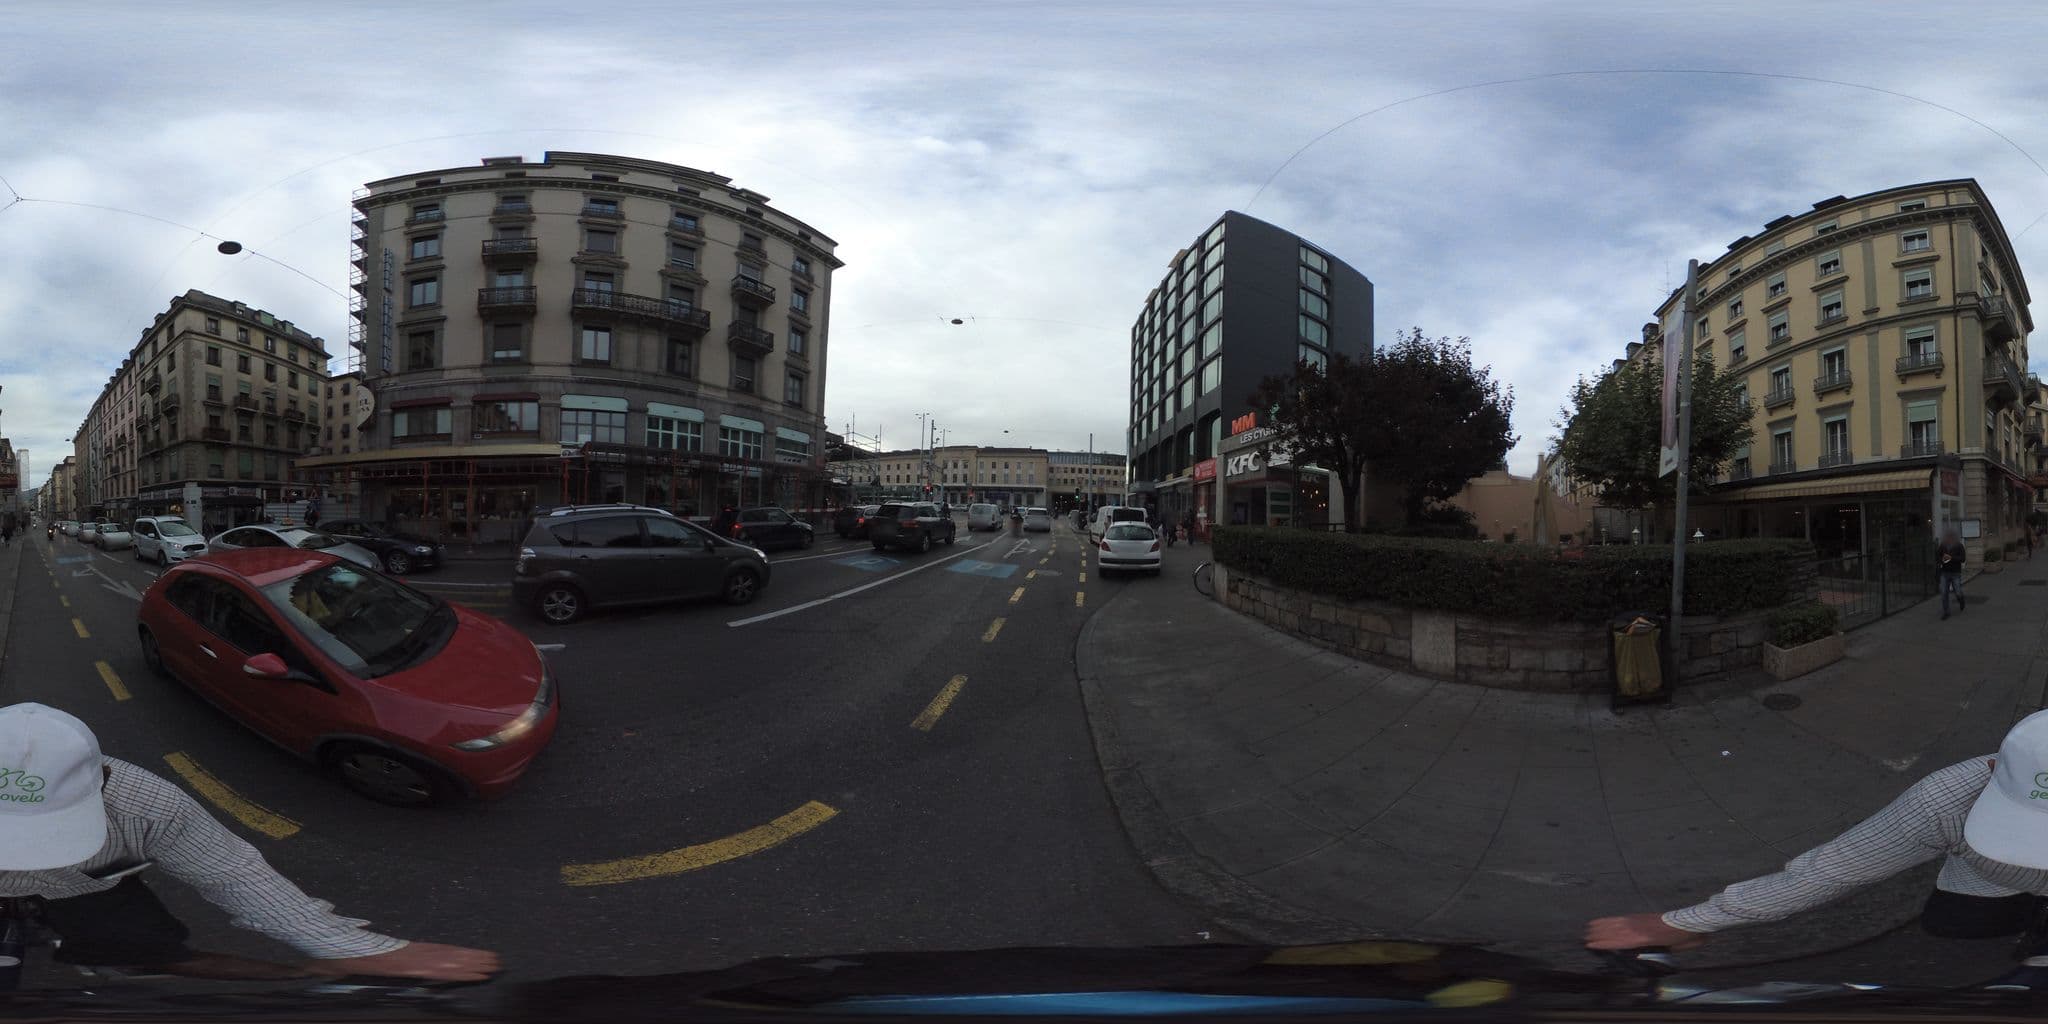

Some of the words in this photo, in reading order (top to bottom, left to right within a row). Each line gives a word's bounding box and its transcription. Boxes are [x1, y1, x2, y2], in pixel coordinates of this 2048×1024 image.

[1231, 411, 1256, 435] MM
[1240, 432, 1253, 444] LES
[1226, 450, 1260, 477] KFC
[0, 792, 45, 803] ovelo
